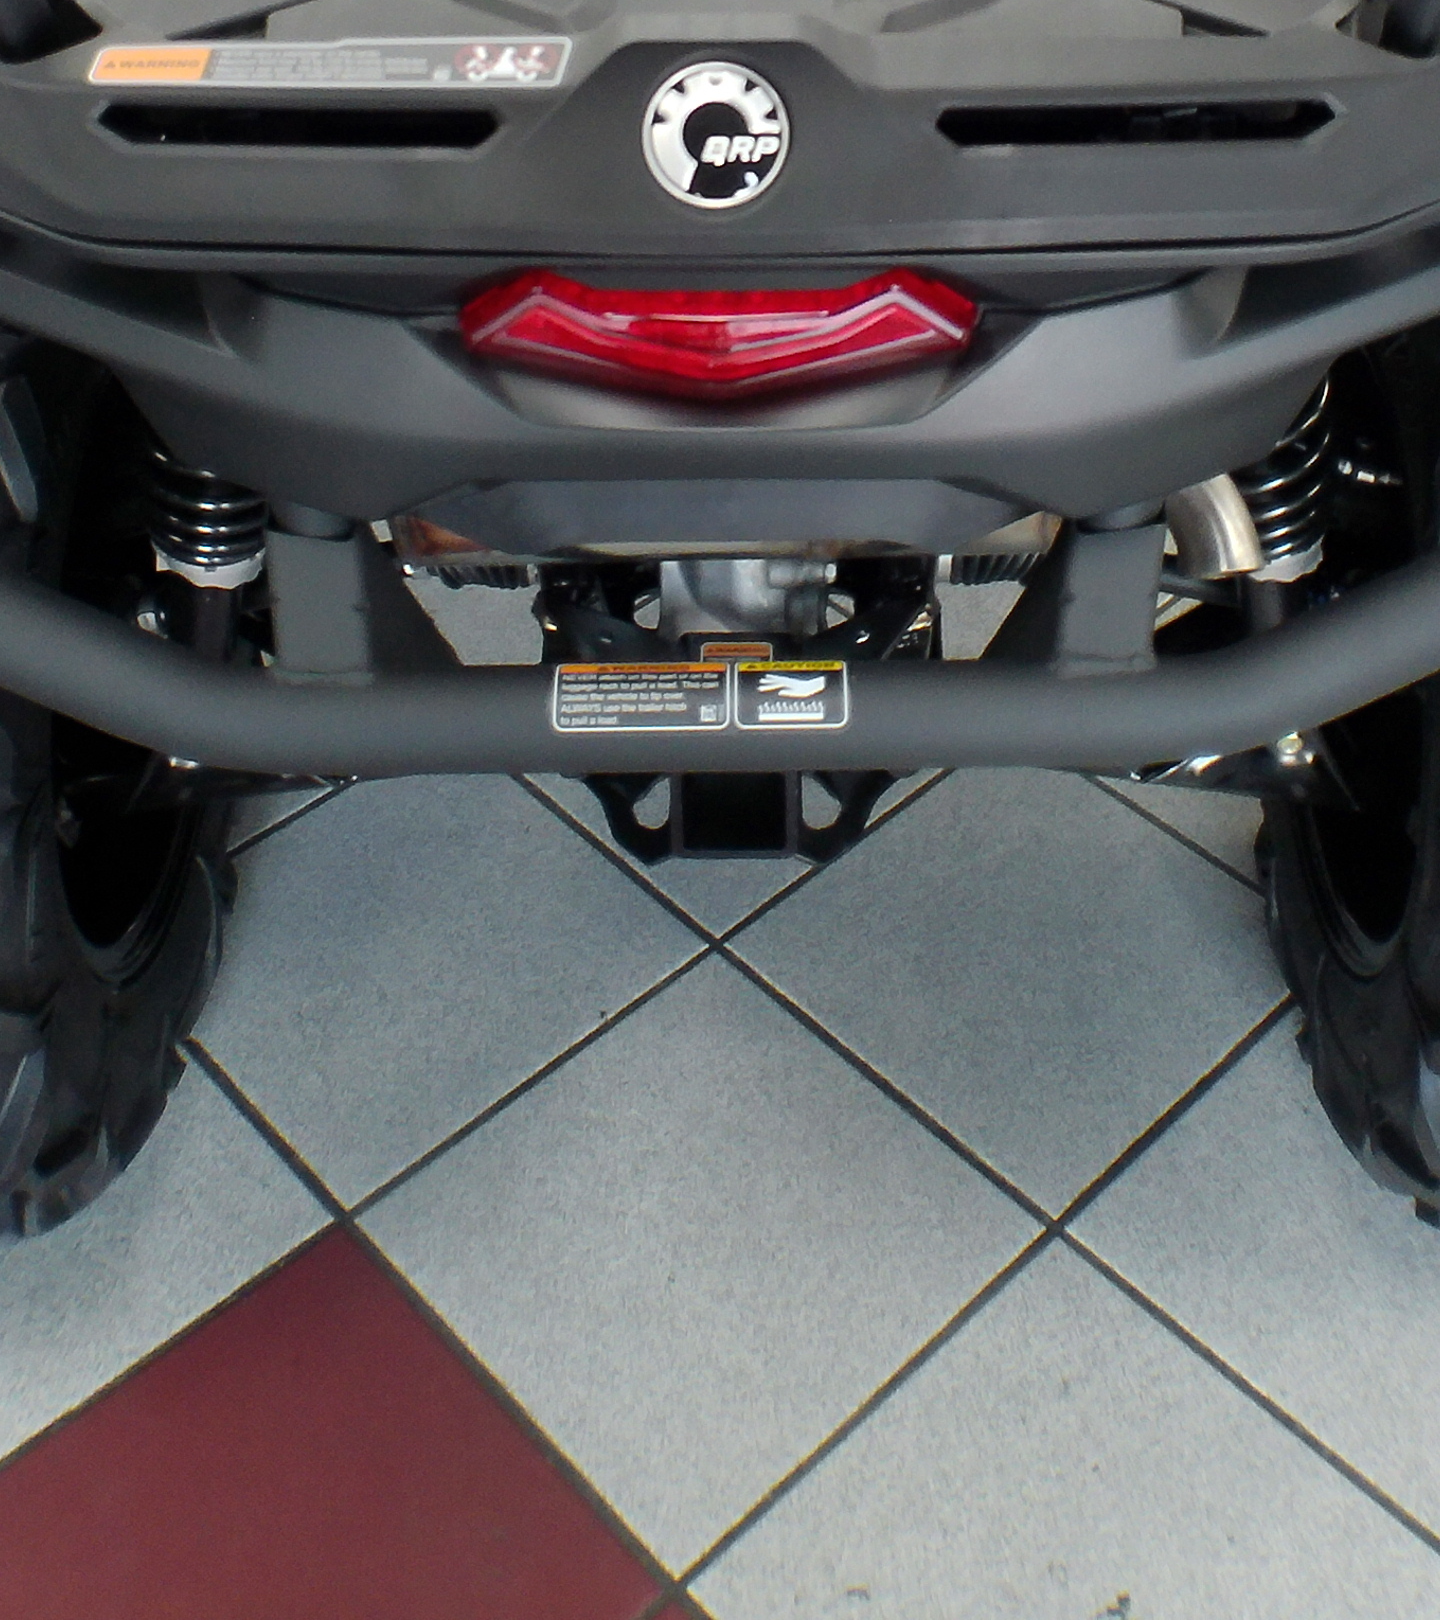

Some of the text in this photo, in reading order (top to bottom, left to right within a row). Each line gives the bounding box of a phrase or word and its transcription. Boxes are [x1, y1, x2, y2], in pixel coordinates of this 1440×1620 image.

[119, 59, 201, 69] WARNING
[613, 664, 690, 672] WARNING
[760, 662, 836, 670] CAUTION
[561, 704, 601, 712] ALWAYS
[571, 716, 588, 725] pull
